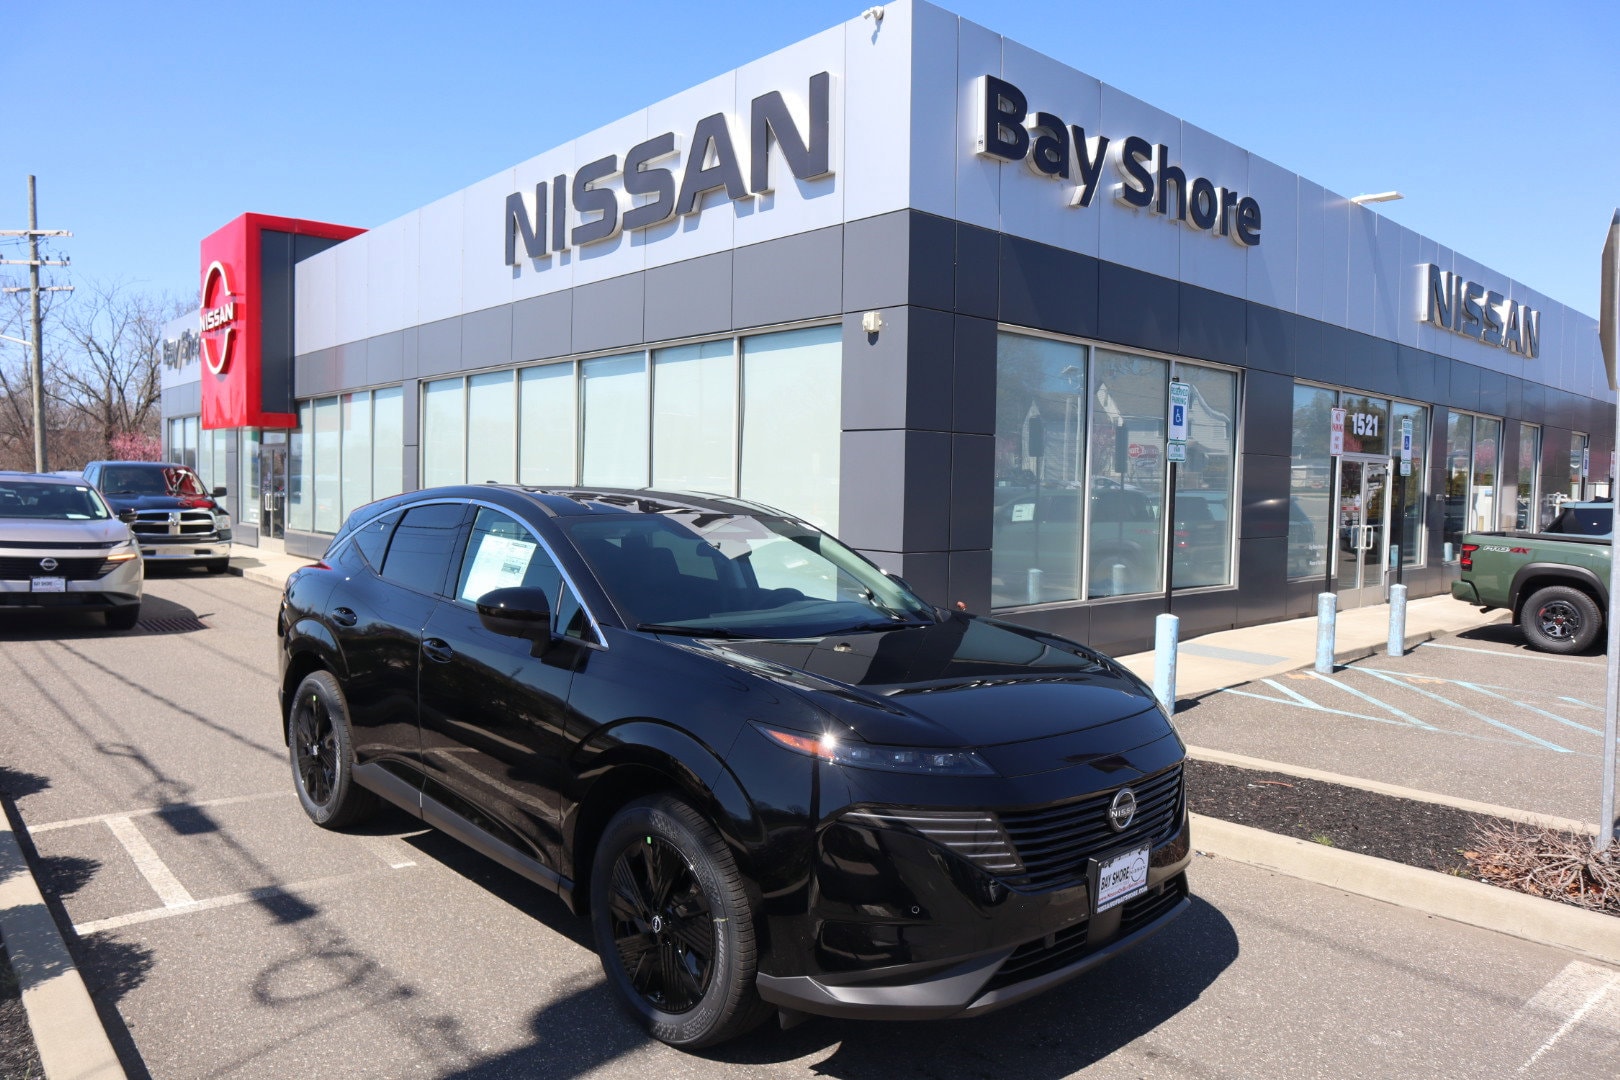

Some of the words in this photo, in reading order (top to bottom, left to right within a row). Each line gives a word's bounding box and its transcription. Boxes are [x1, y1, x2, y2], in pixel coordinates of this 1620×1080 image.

[504, 70, 833, 267] NISSAN
[978, 74, 1110, 208] Bay
[1114, 135, 1262, 246] Shore
[200, 301, 234, 333] NISSAN
[1419, 262, 1540, 359] NISSAN
[1352, 412, 1379, 437] 1521
[1100, 874, 1112, 891] BAY
[1111, 866, 1130, 886] SHORE
